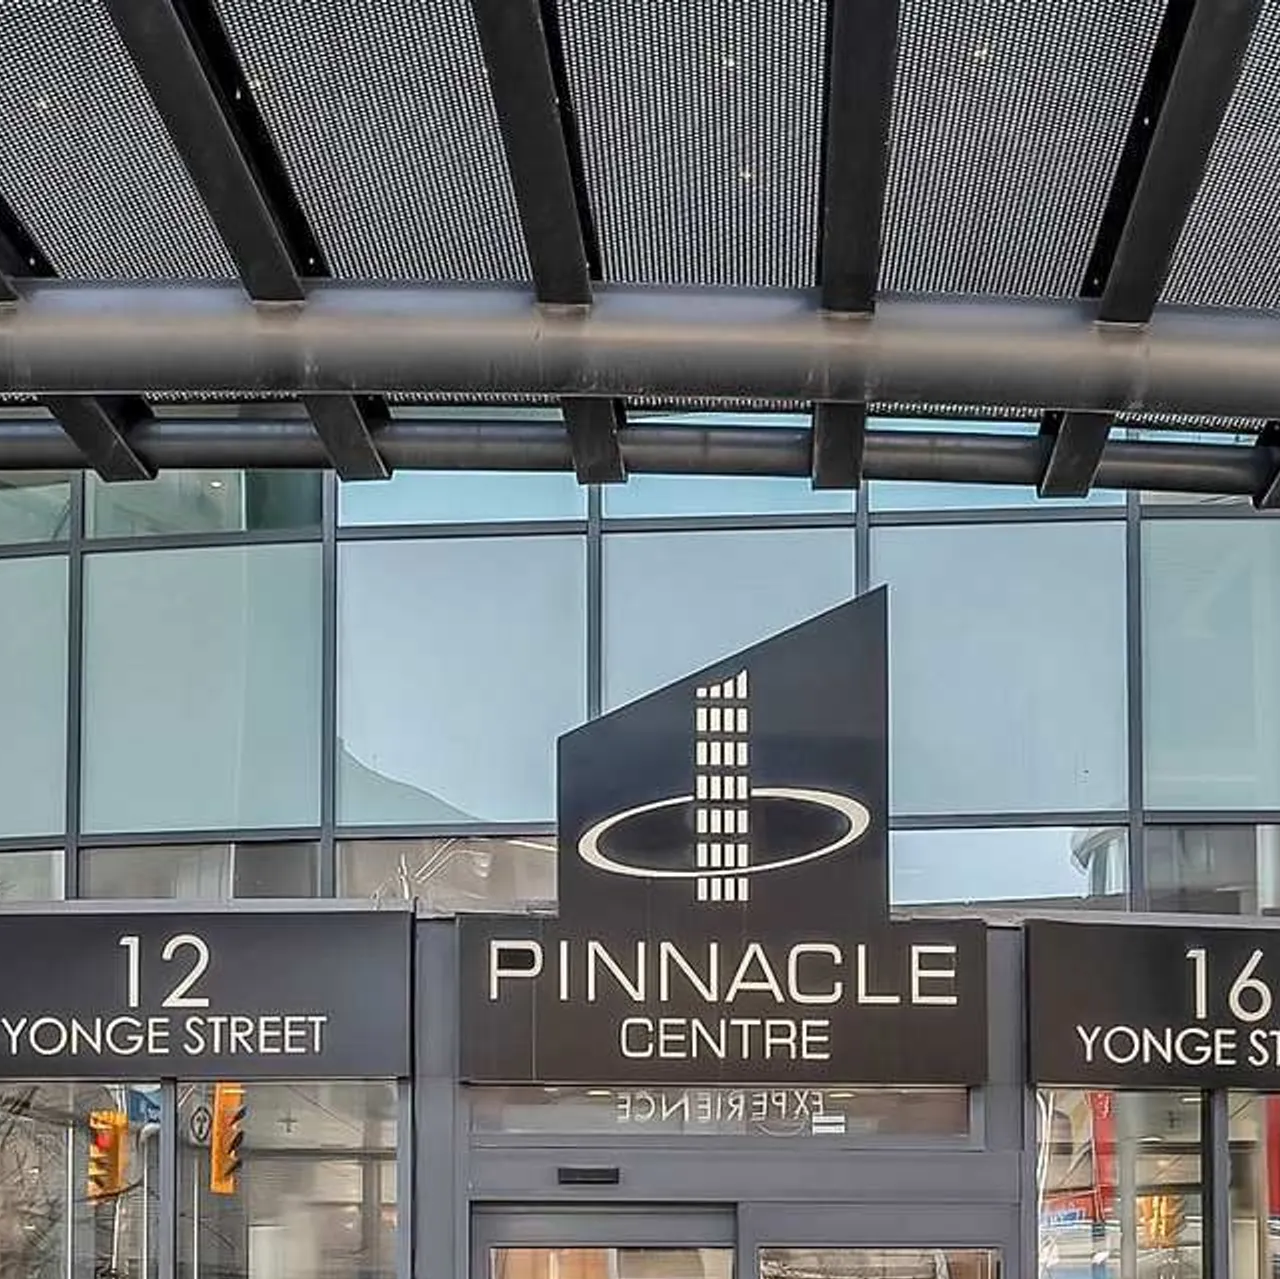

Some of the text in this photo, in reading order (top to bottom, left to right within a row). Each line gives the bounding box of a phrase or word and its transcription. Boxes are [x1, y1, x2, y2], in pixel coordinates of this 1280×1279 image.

[119, 934, 210, 1008] 12
[490, 939, 958, 1005] PINNACLE
[1186, 949, 1272, 1022] 16
[1, 1015, 328, 1056] YONGE STREET
[621, 1017, 831, 1060] CENTRE
[1076, 1024, 1237, 1066] YONGE
